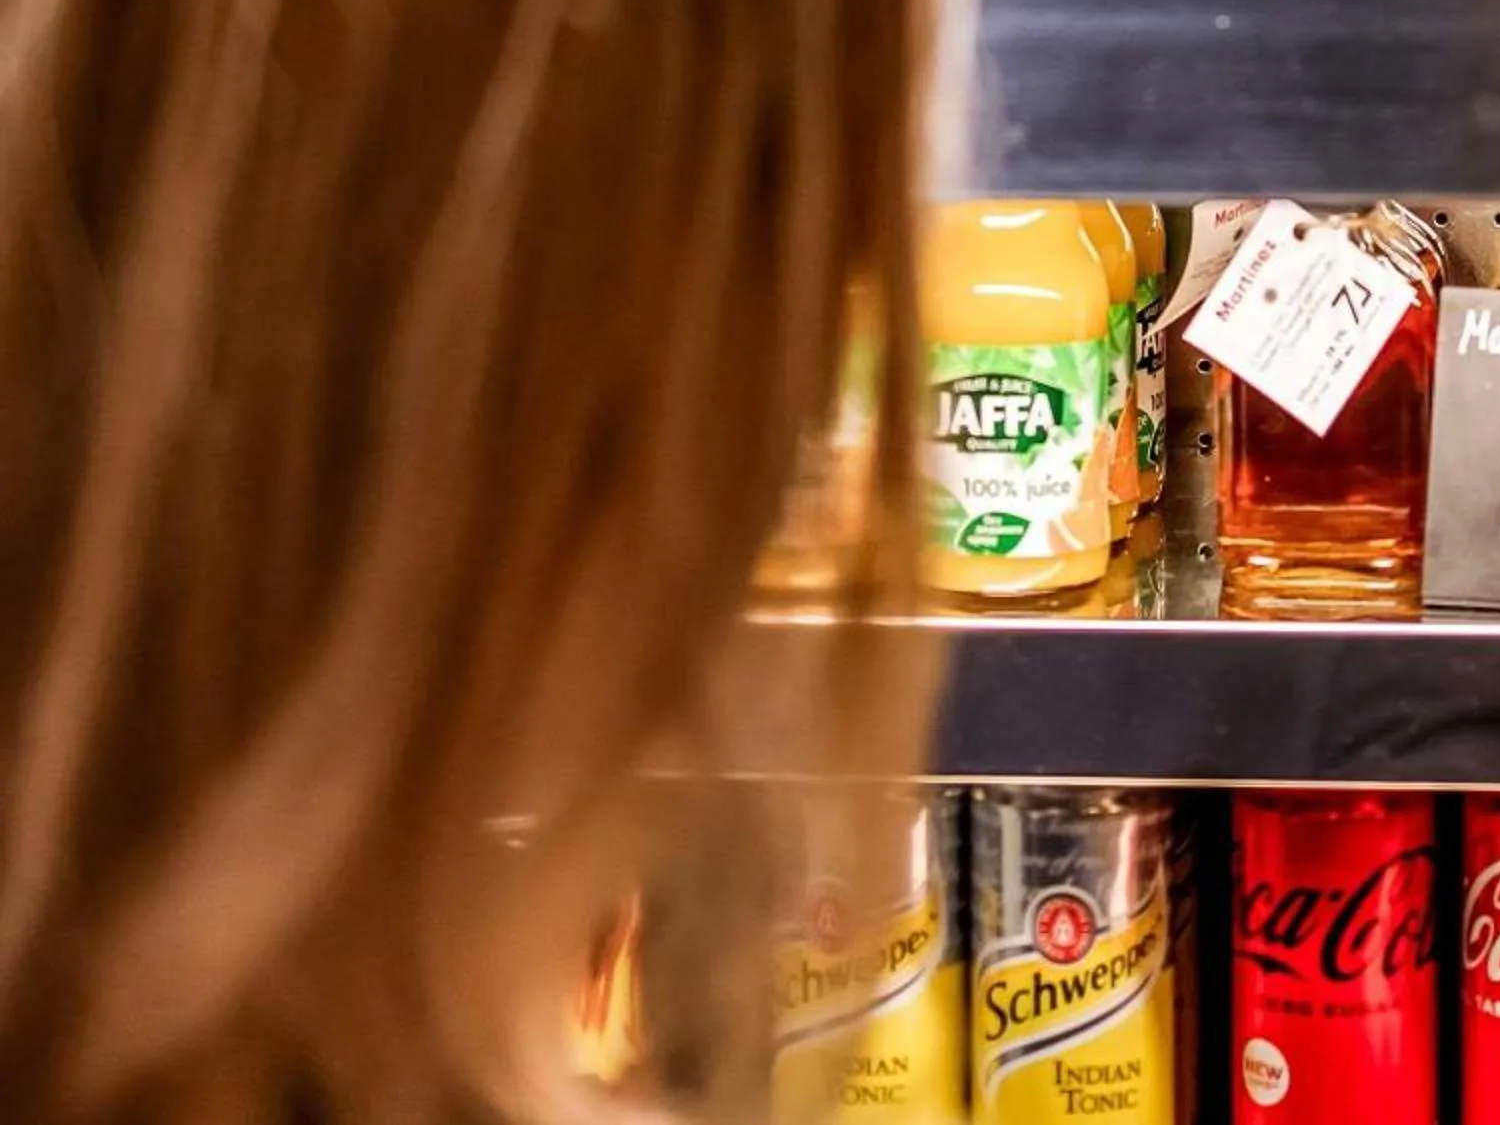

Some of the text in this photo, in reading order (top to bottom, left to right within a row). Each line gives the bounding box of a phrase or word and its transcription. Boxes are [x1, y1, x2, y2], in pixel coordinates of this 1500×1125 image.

[1215, 239, 1278, 323] Martinez
[935, 390, 1055, 438] JAFFA
[963, 473, 1071, 502] 100% juice
[1055, 1059, 1142, 1086] INDIAN
[840, 1084, 908, 1106] ONIC
[1060, 1086, 1139, 1116] TONIC
